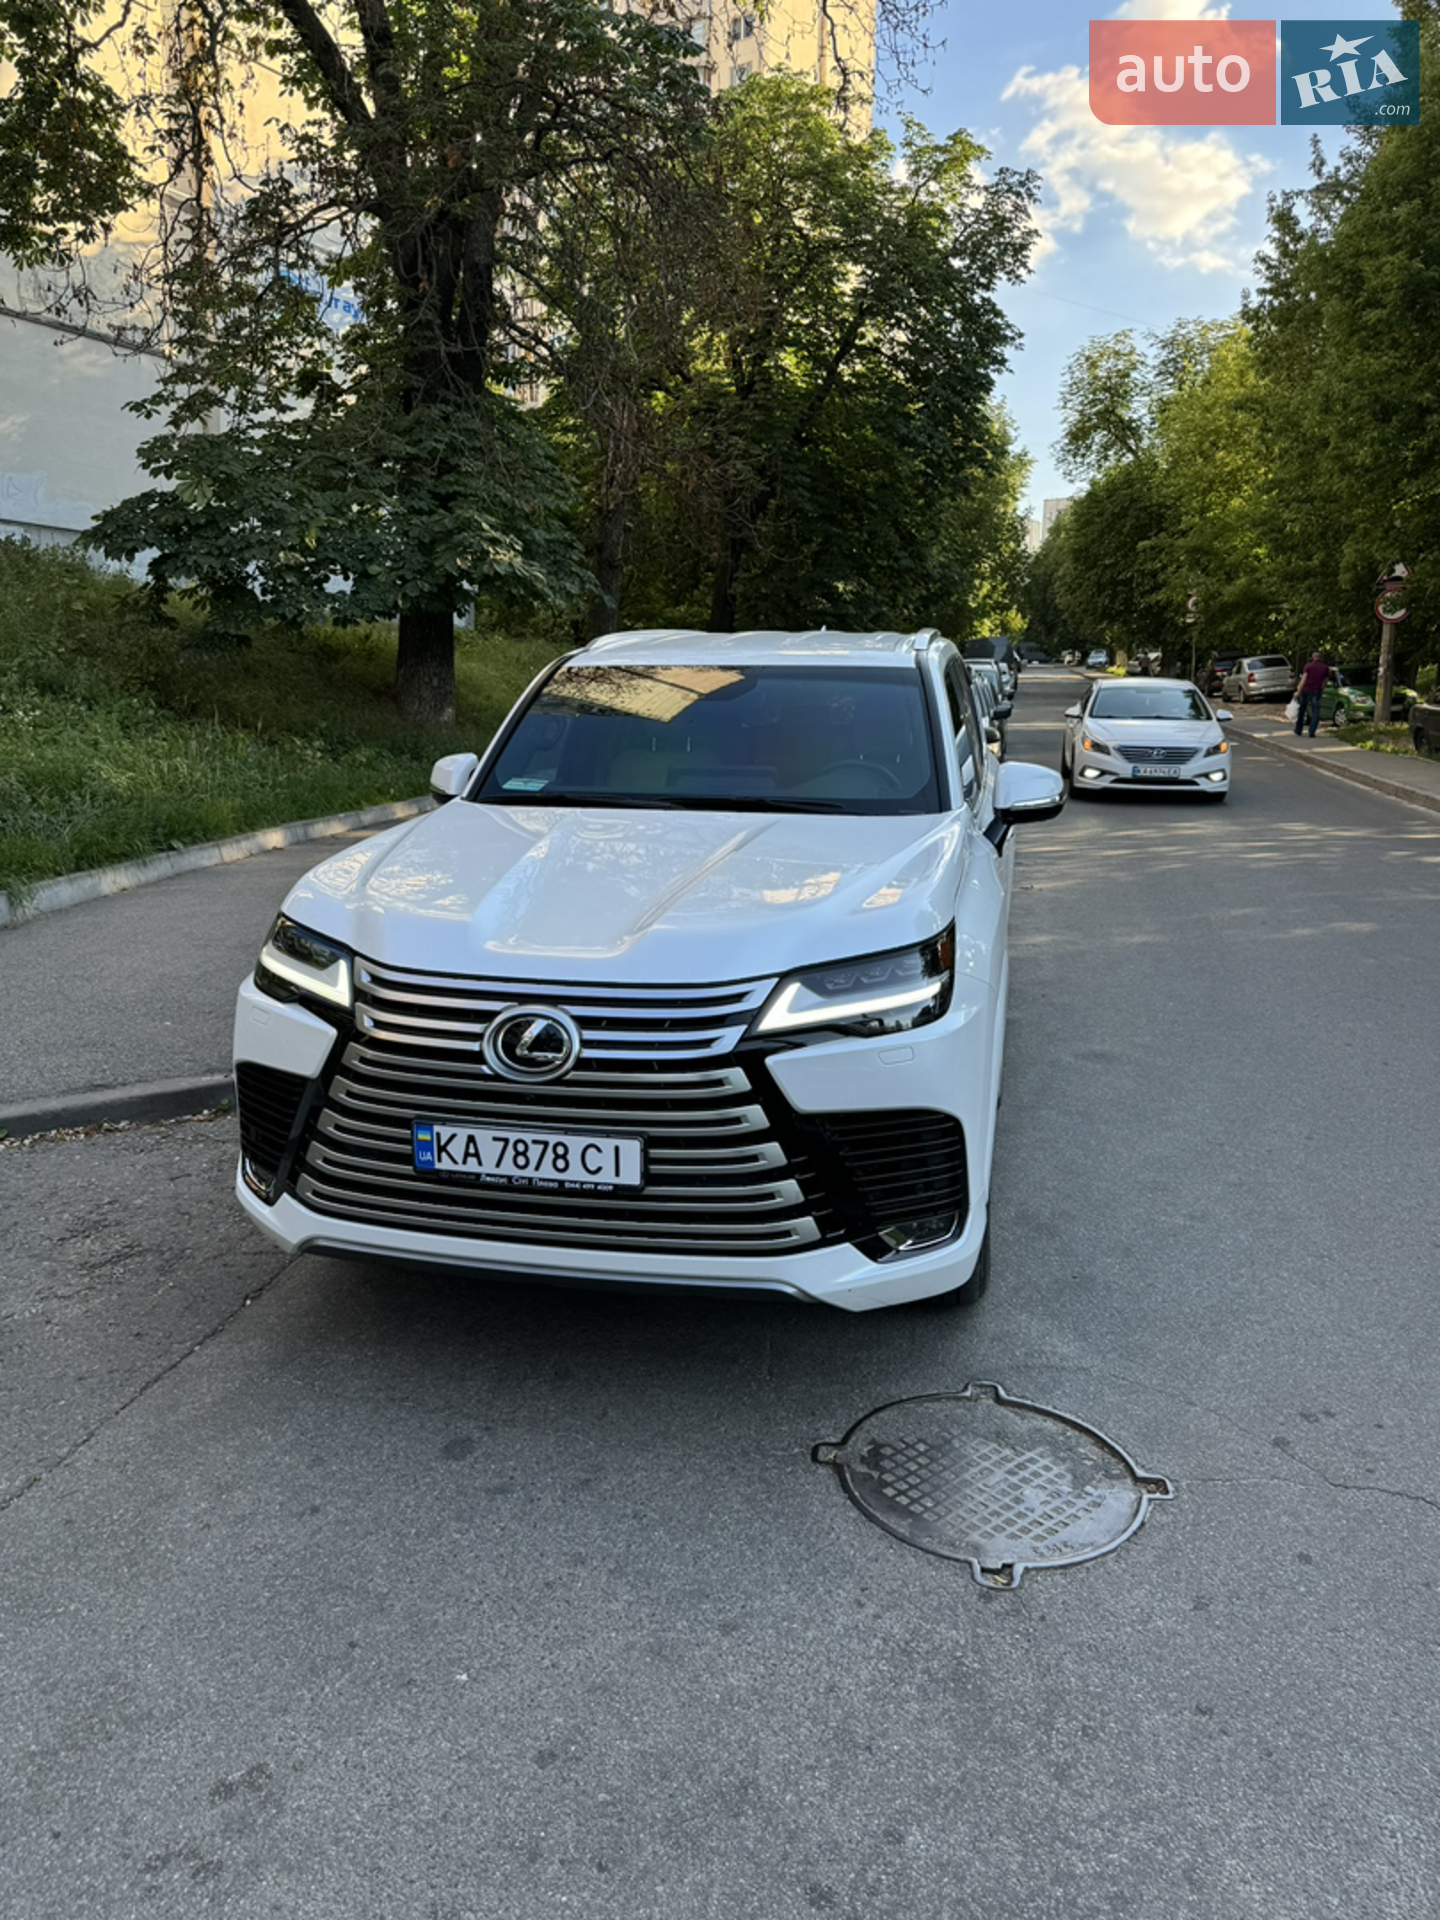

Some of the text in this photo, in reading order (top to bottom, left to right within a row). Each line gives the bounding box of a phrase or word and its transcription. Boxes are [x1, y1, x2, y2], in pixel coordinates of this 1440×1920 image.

[419, 1151, 433, 1162] UA
[436, 1131, 621, 1178] KA 7878 CI
